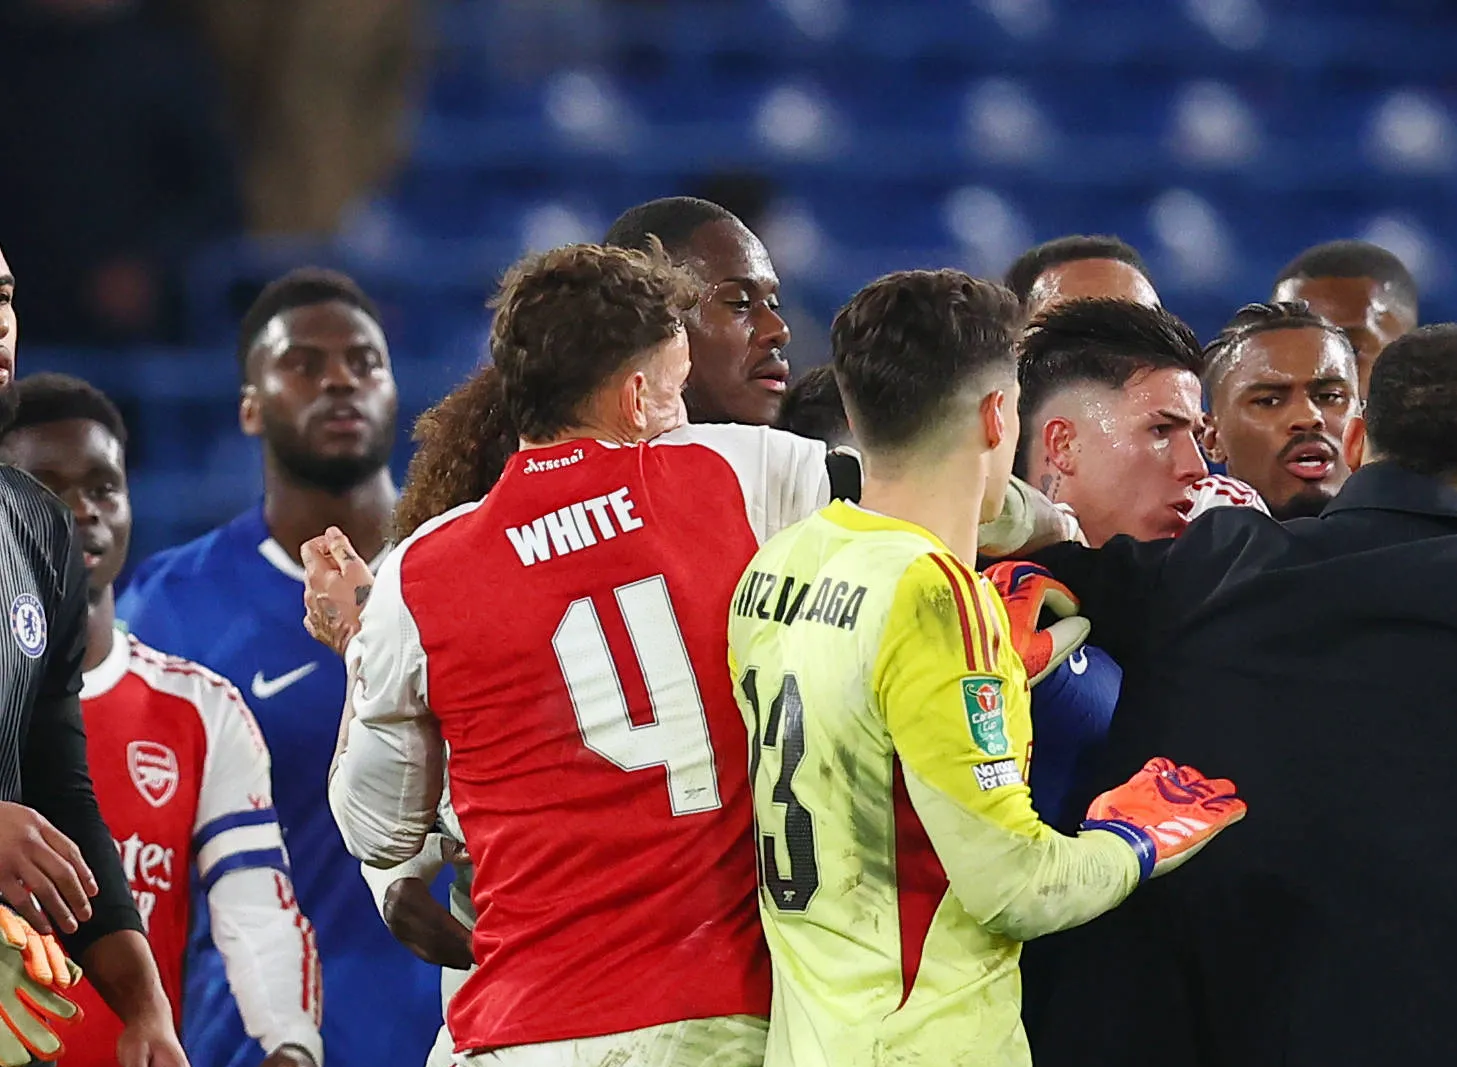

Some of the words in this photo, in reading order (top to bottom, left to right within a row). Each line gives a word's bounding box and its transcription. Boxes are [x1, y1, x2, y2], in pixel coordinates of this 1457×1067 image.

[523, 448, 584, 475] Arsenal
[505, 486, 644, 567] WHITE
[551, 574, 723, 817] 4
